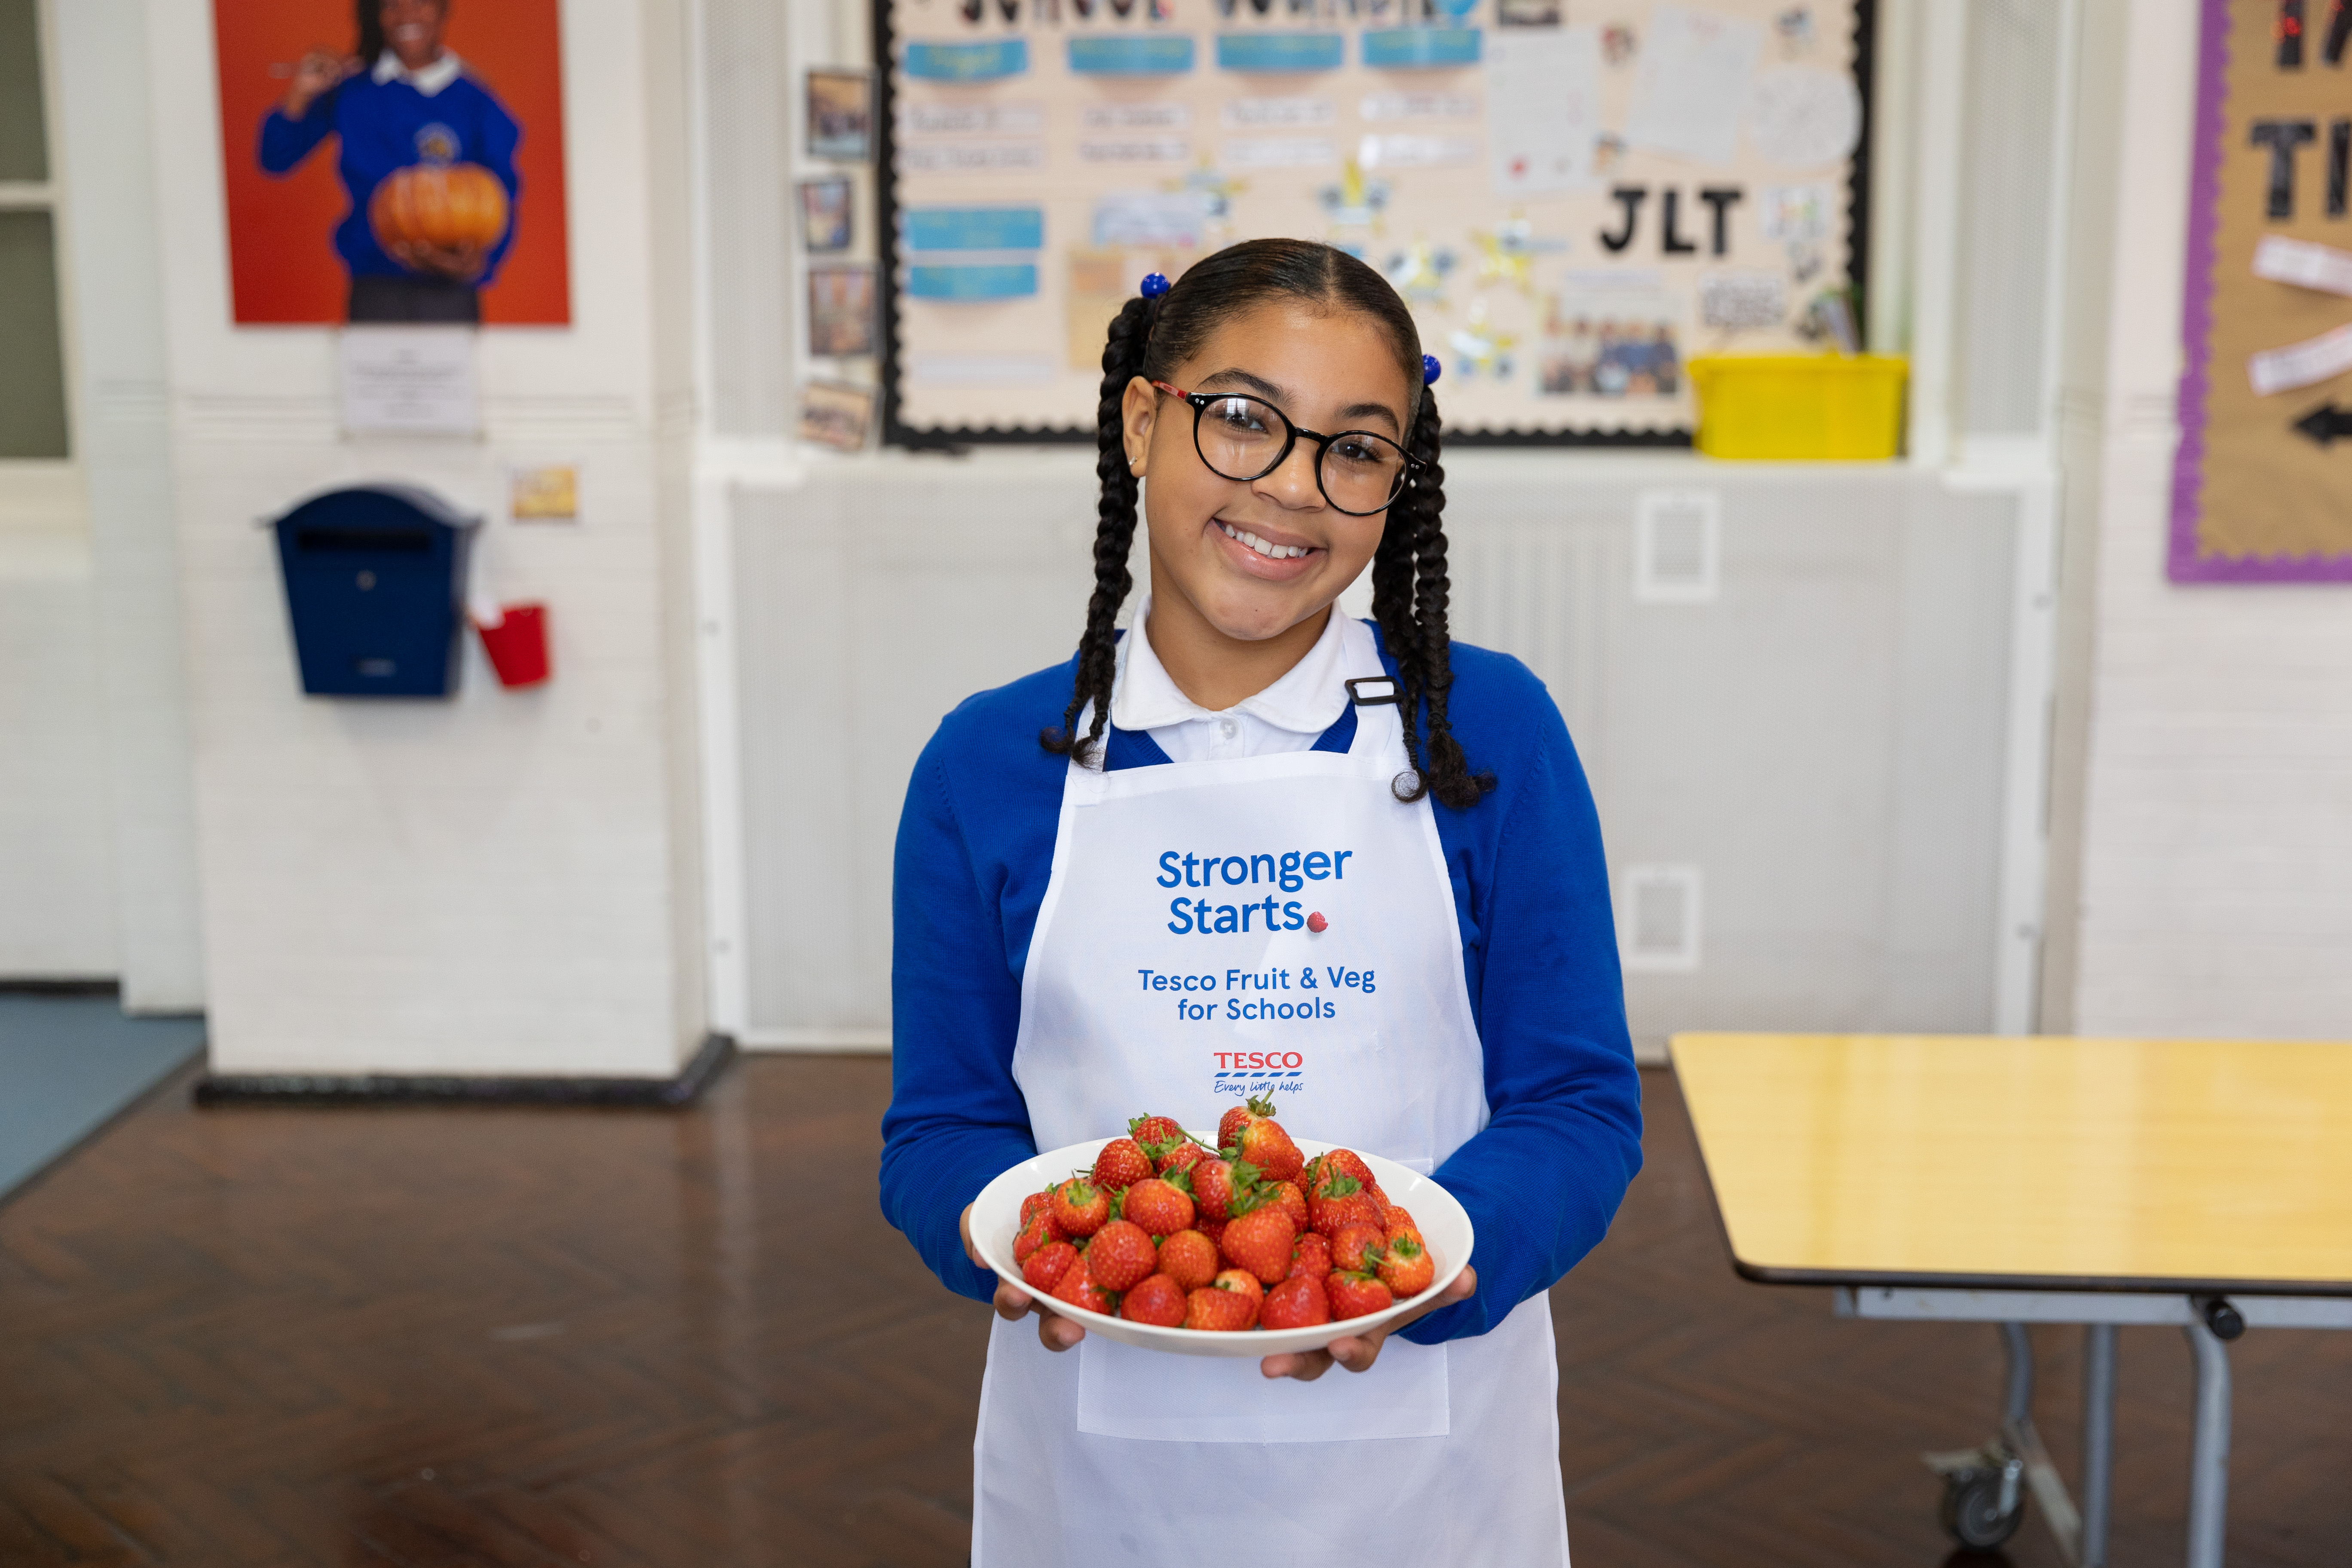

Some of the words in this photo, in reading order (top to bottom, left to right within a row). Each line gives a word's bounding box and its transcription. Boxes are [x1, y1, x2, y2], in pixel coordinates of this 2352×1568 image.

[1598, 185, 1744, 257] JLT
[1156, 850, 1353, 893] Stronger
[1138, 969, 1216, 992] Tesco
[1226, 967, 1290, 991] Fruit
[1299, 966, 1319, 989] &
[1327, 965, 1376, 994] Veg
[1178, 998, 1218, 1021] for
[1226, 996, 1336, 1020] Schools
[1213, 1051, 1303, 1069] TESCO
[1214, 1080, 1246, 1097] Every
[1250, 1081, 1275, 1092] little
[1279, 1081, 1304, 1094] helps
